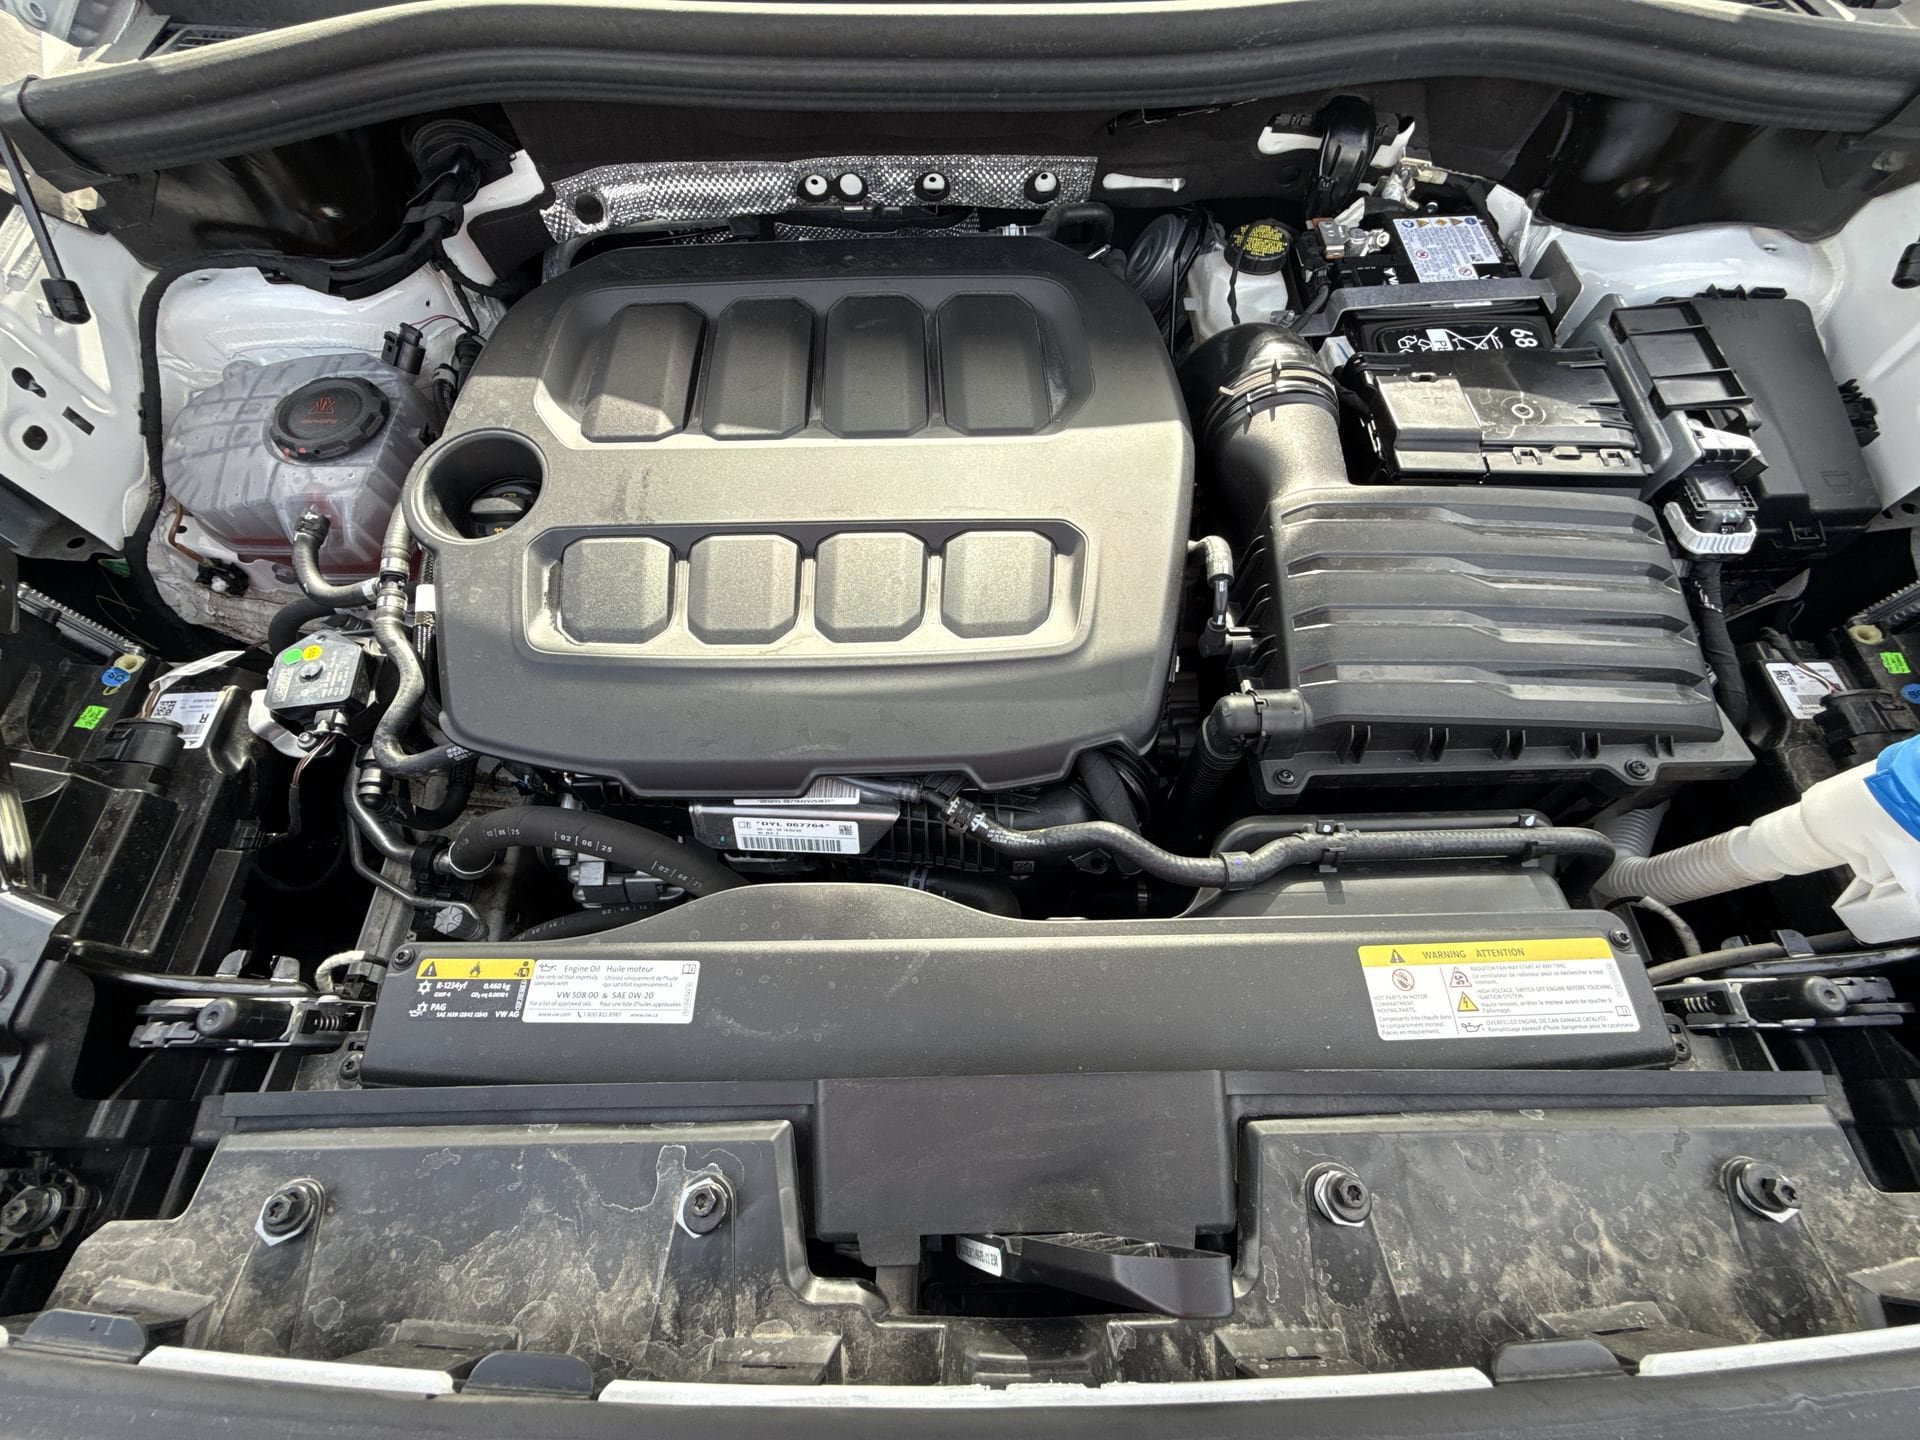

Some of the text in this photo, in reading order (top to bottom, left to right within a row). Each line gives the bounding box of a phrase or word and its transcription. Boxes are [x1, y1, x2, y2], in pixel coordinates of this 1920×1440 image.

[560, 834, 613, 853] 02 06 25
[1422, 947, 1525, 960] WARNING ATTENTION
[564, 965, 601, 974] Engine Oil
[606, 965, 626, 973] Huile
[435, 981, 469, 992] R-1234yf
[483, 982, 512, 991] 0.460 kg
[556, 991, 571, 999] VW
[571, 991, 587, 999] 508
[587, 991, 599, 999] 00
[611, 991, 626, 999] SAE
[628, 991, 655, 999] 0W-20
[430, 1003, 448, 1011] PAG
[495, 1010, 520, 1018] VW AG
